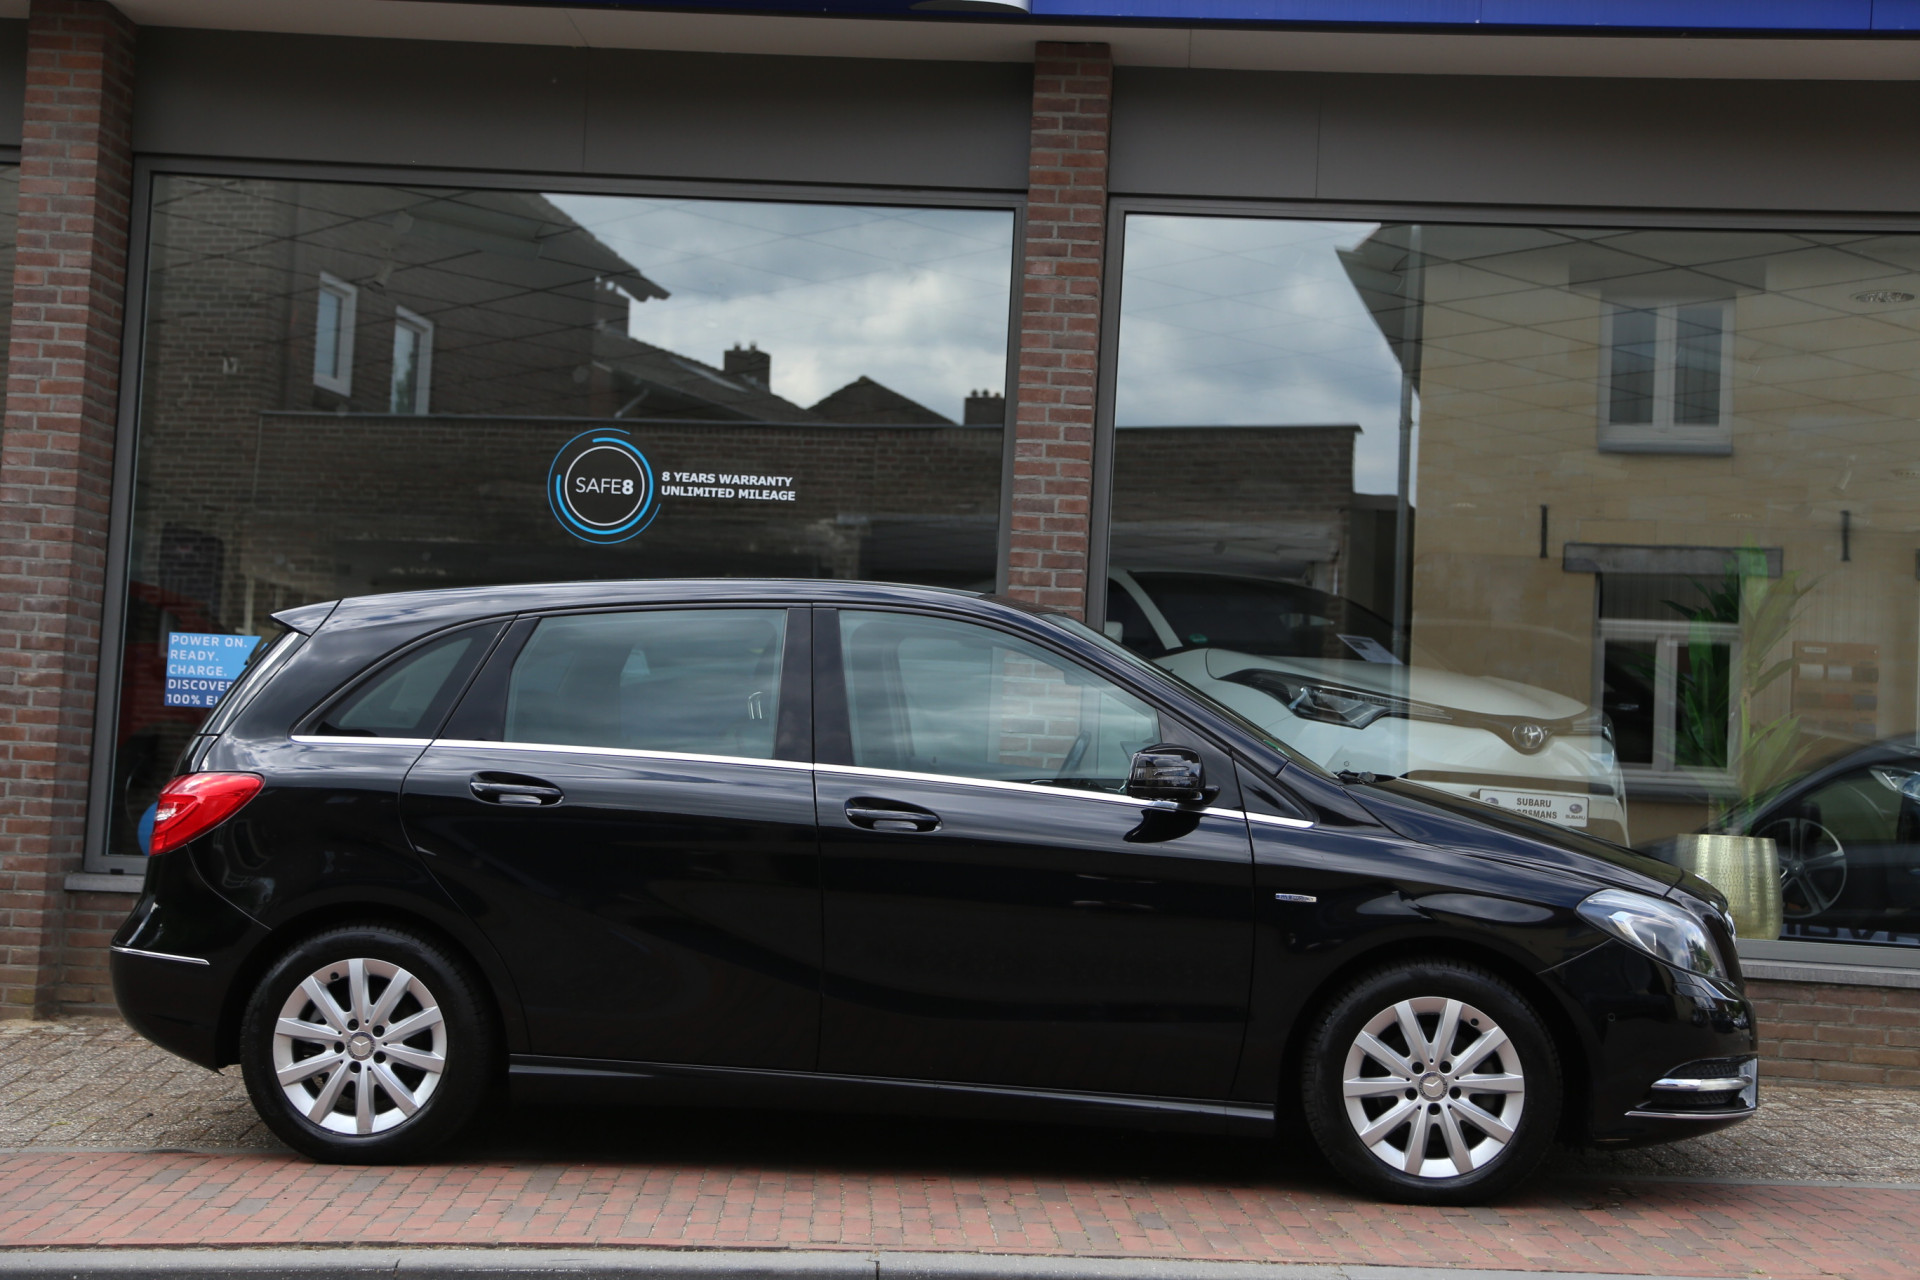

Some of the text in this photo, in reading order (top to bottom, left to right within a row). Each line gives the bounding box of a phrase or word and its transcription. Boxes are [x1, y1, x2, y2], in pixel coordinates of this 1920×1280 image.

[661, 471, 793, 487] 8 YEARS WARRANTY
[575, 476, 634, 496] SAFE8
[661, 485, 796, 502] UNLIMITED MILEAGE
[171, 635, 248, 648] POWER ON.
[170, 650, 219, 661] READY.
[169, 664, 227, 676] CHARGE.
[166, 693, 201, 705] 100%
[1516, 797, 1552, 808] SUBARU
